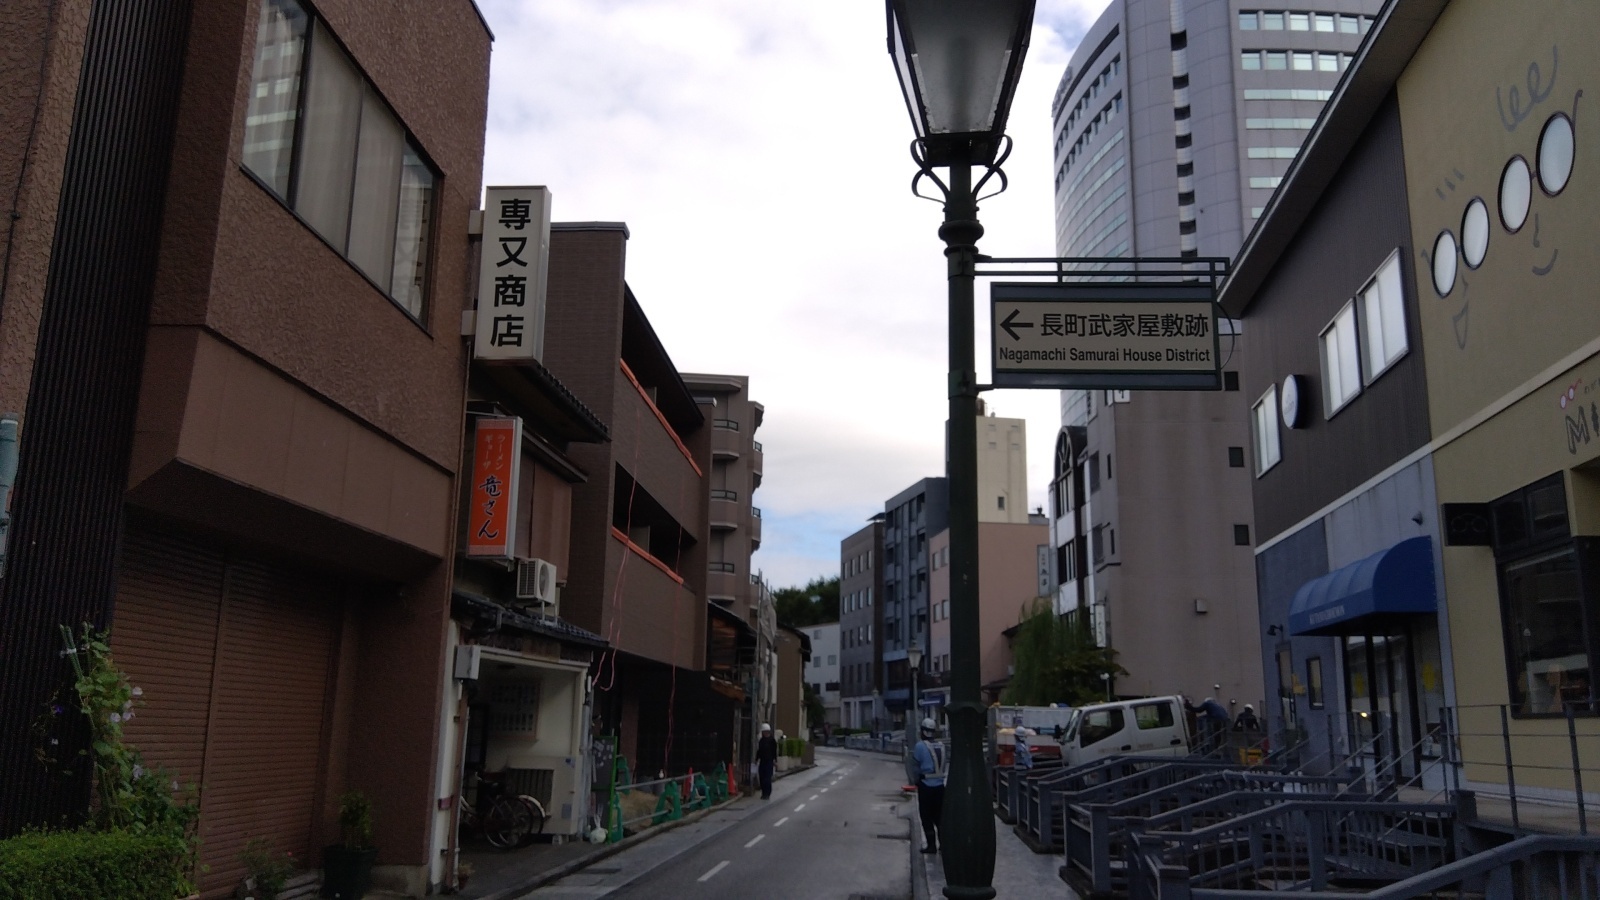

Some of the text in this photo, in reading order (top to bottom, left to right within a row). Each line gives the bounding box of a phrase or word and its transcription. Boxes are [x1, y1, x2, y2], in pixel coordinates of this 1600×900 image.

[490, 198, 532, 347] 専又商店
[1040, 312, 1209, 338] 長町武家屋敷跡
[999, 347, 1211, 364] Nagamachi Samurai House District
[482, 433, 492, 471] ギョーザ
[495, 434, 506, 471] ラーメン
[477, 475, 502, 540] 竜さん
